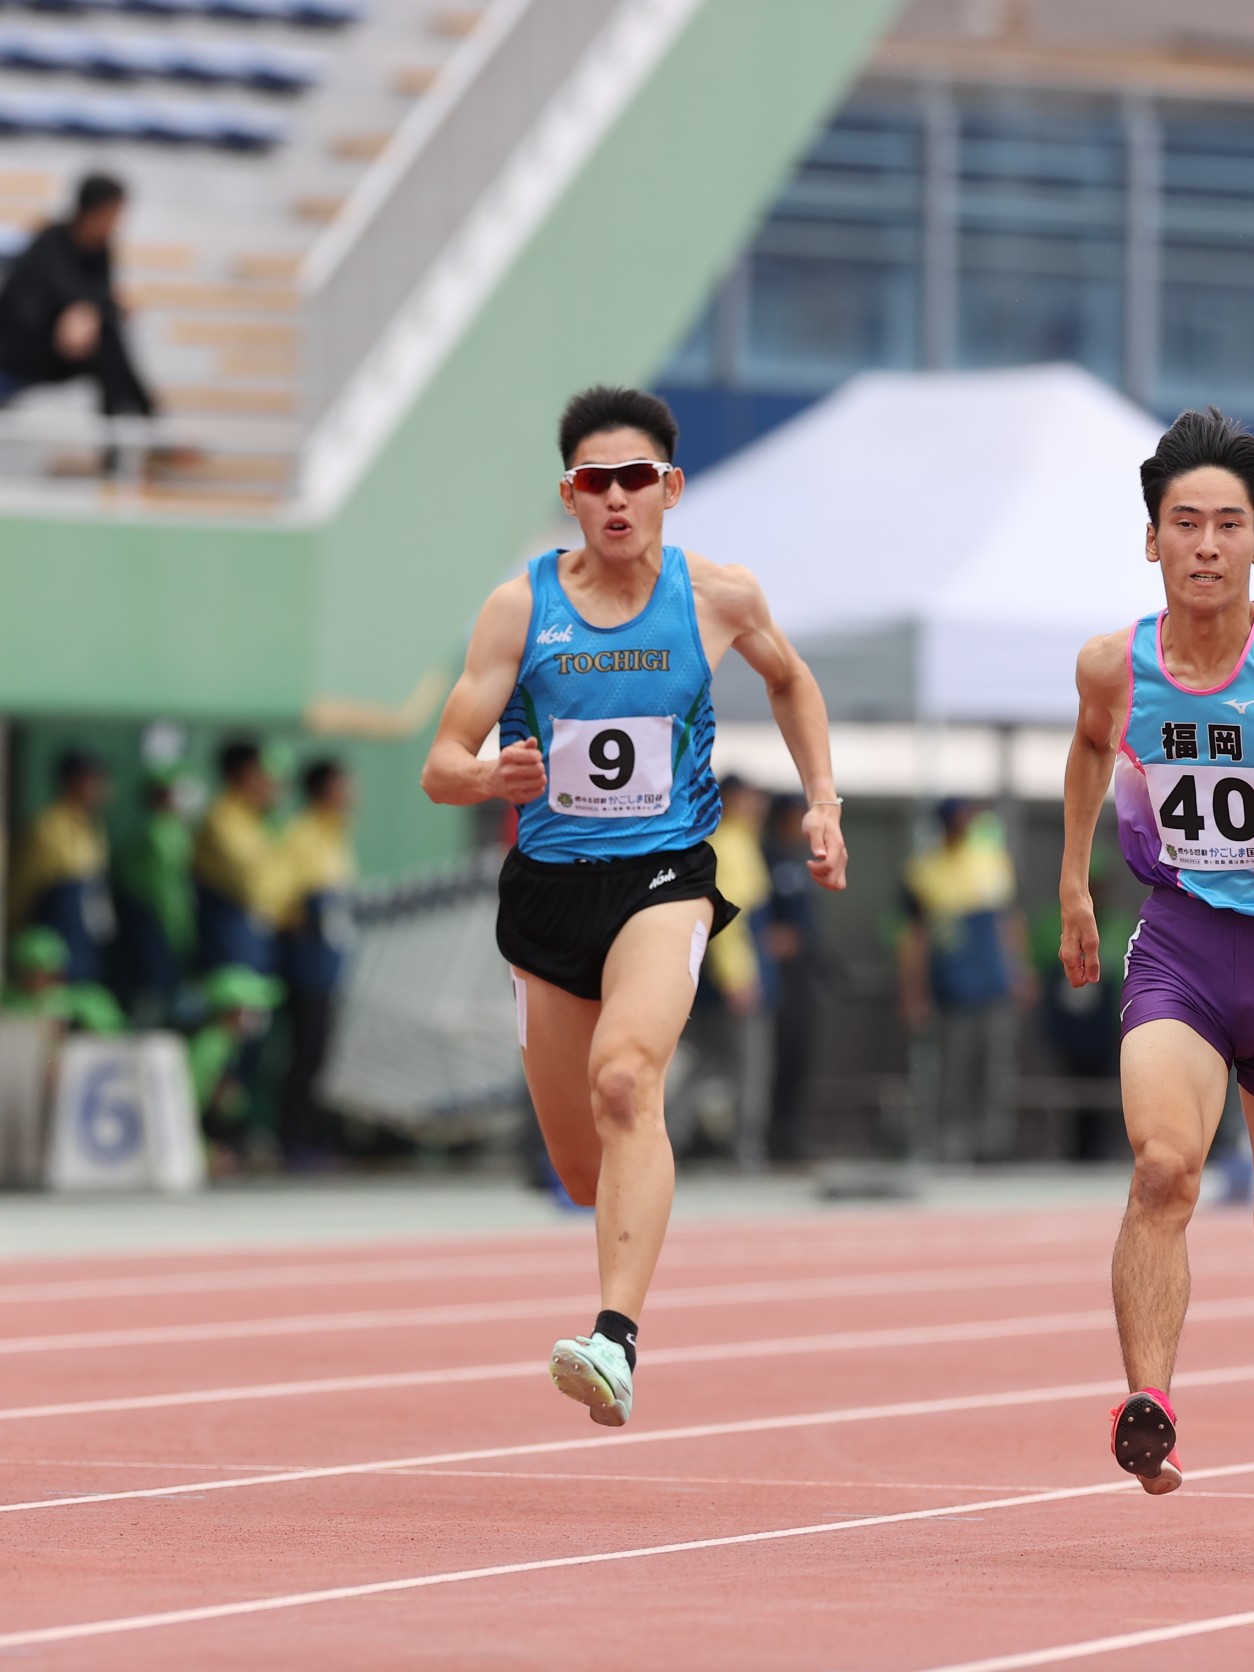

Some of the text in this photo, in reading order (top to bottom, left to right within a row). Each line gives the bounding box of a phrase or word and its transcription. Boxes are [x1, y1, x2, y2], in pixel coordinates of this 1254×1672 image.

[554, 649, 670, 674] TOCHIGI
[588, 728, 636, 791] 9
[1161, 721, 1243, 761] 福岡
[77, 1059, 144, 1168] 6
